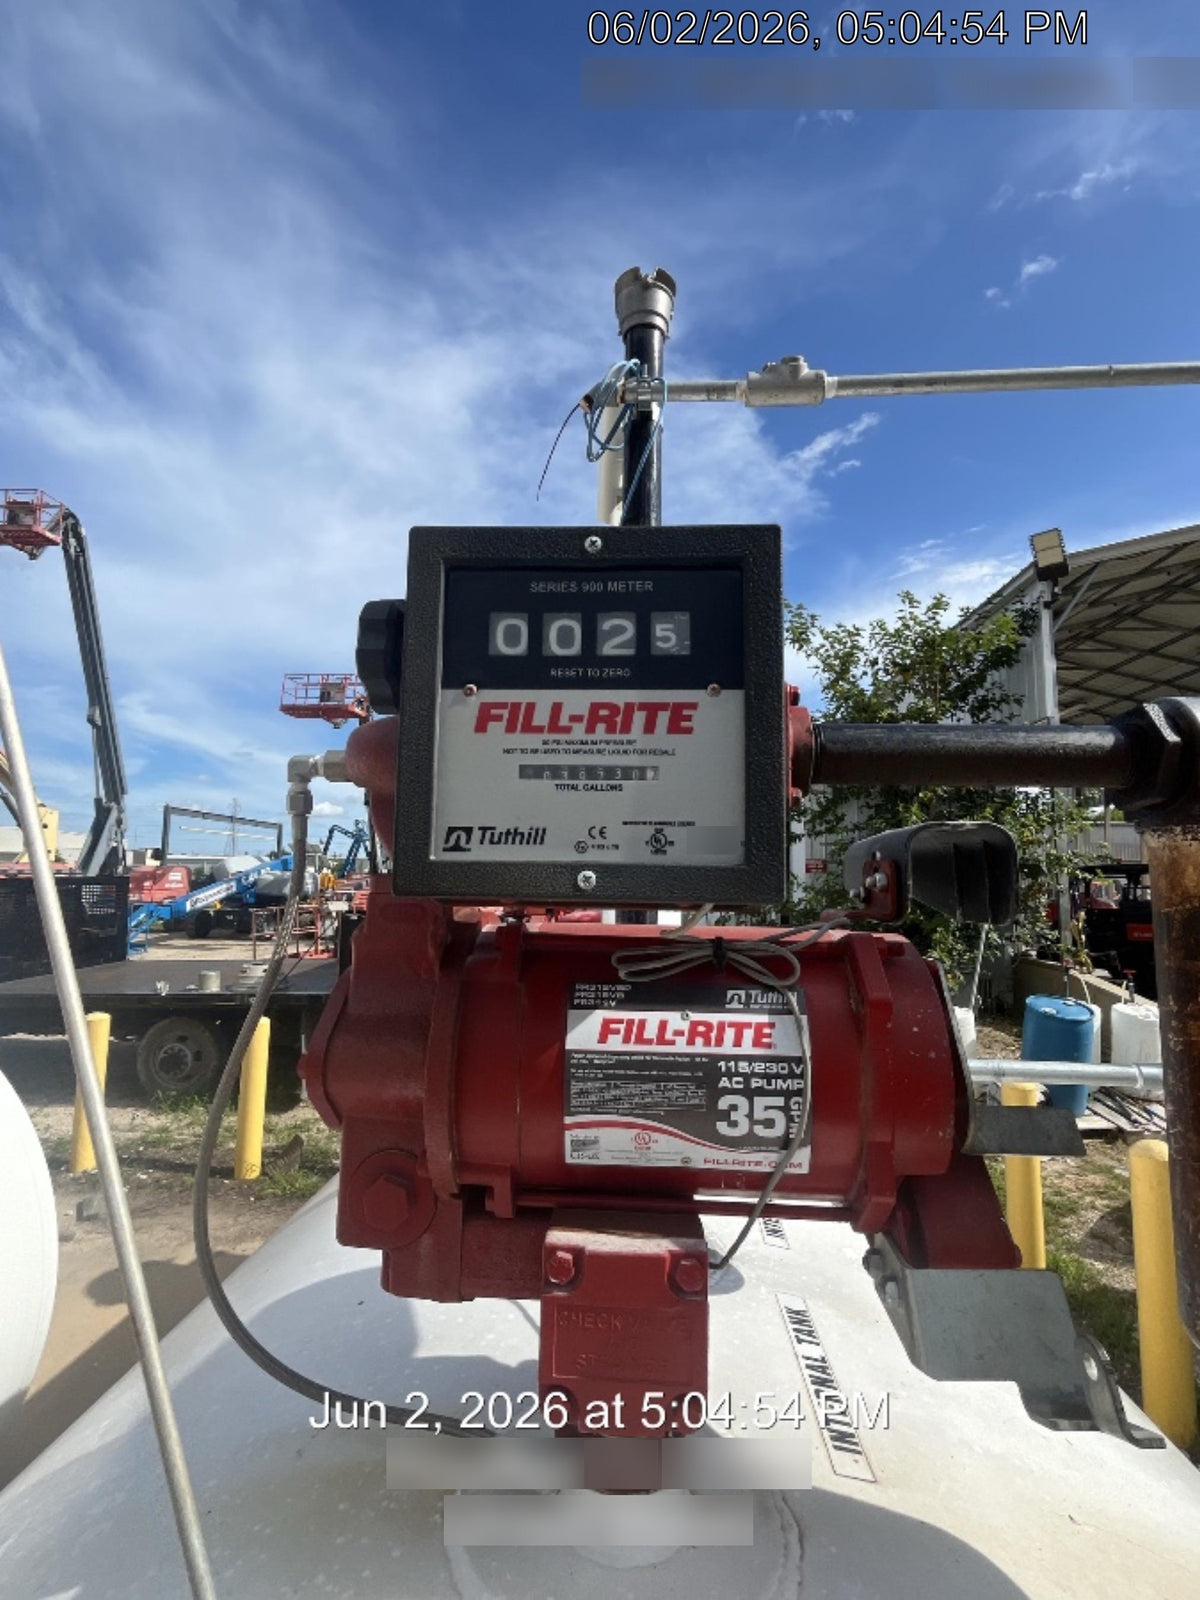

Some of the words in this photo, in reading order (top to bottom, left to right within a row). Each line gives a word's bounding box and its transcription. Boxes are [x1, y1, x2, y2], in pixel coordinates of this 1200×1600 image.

[529, 582, 577, 592] SERIES
[581, 582, 604, 592] 900
[607, 581, 653, 592] METER
[550, 668, 583, 677] RESET
[587, 668, 600, 677] TO
[602, 668, 631, 677] ZERO
[474, 702, 699, 735] FILL-RITE
[555, 783, 580, 791] TOTAL
[582, 783, 622, 792] GALLONS
[477, 826, 547, 845] Tuthill
[597, 1017, 776, 1049] FILL-RITE
[718, 1061, 788, 1074] 115/230
[791, 1063, 804, 1074] V
[718, 1077, 744, 1089] AC
[751, 1078, 805, 1090] PUMP
[716, 1094, 787, 1138] 35
[703, 1157, 803, 1169] FILLRITE.CM
[784, 1306, 821, 1346] TANK
